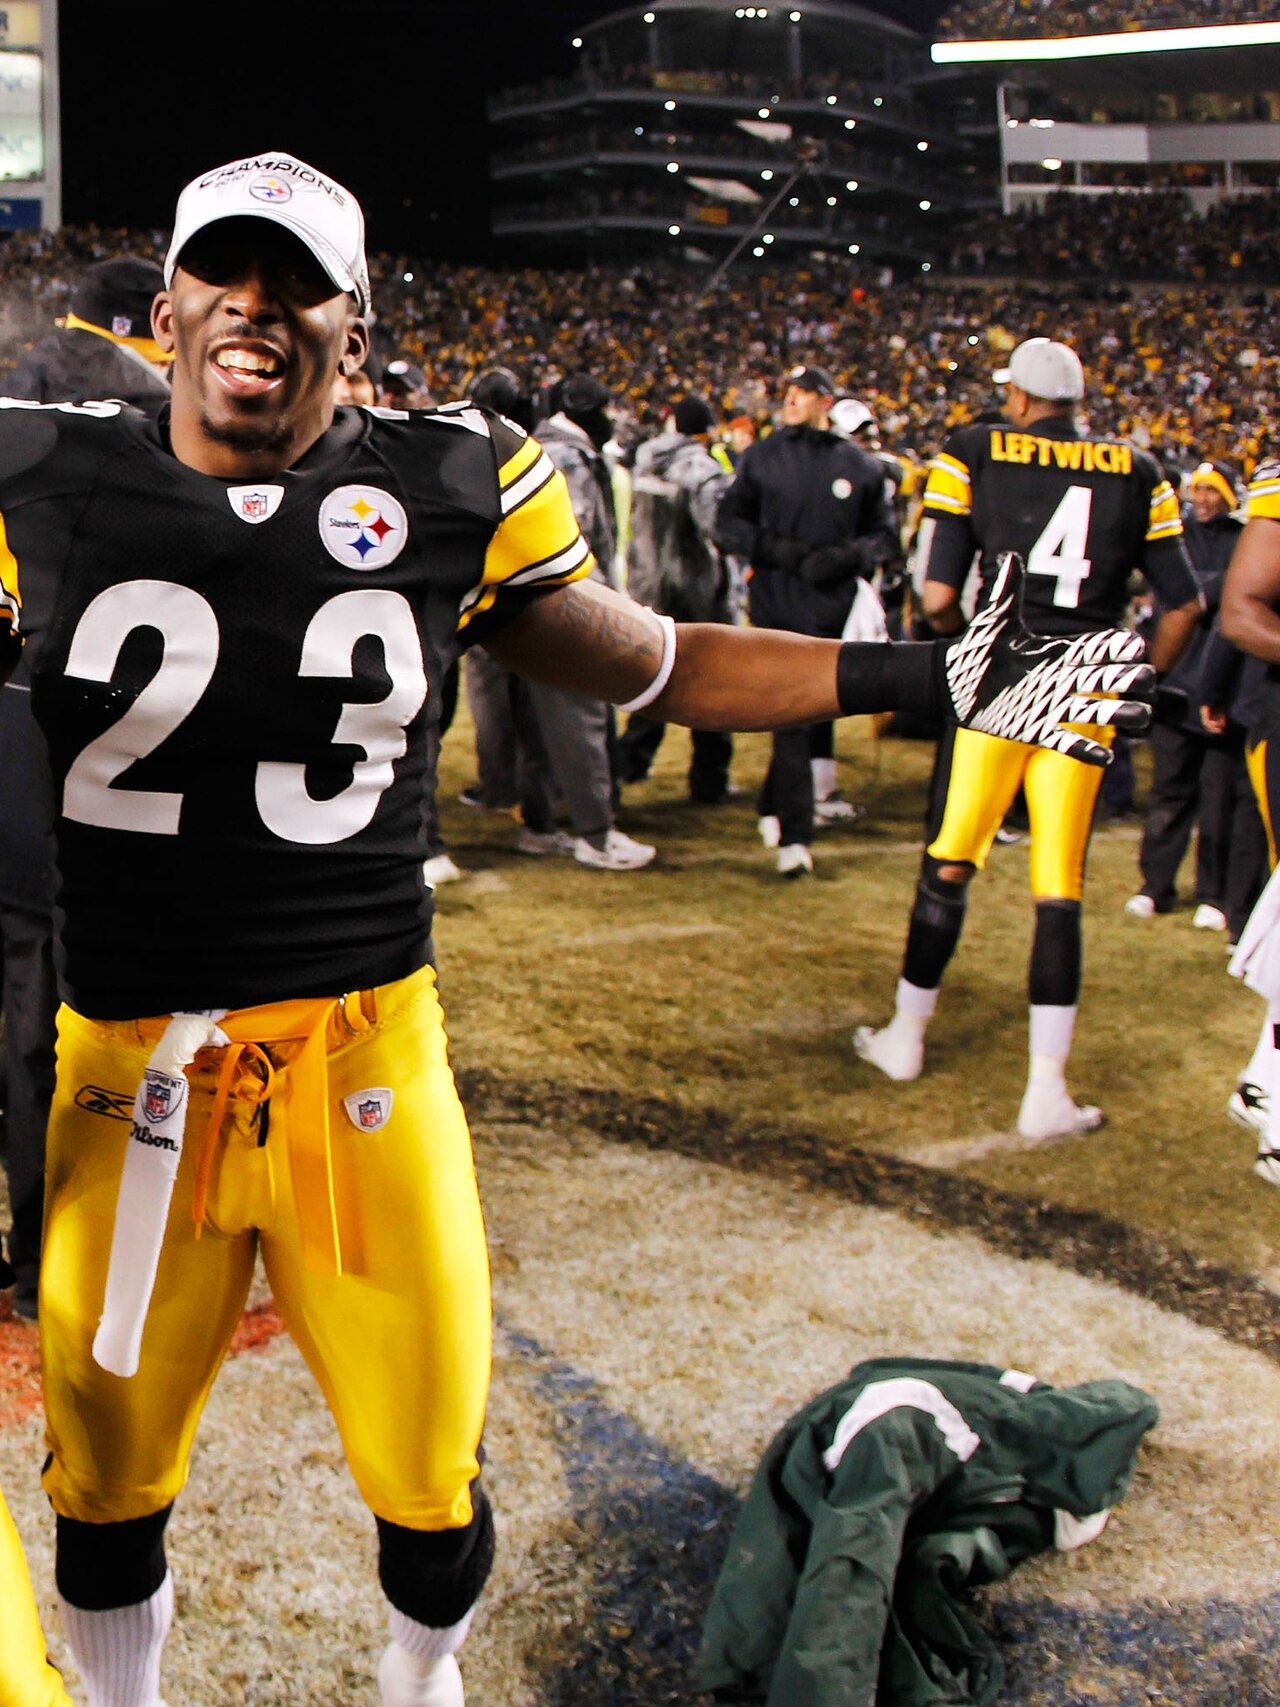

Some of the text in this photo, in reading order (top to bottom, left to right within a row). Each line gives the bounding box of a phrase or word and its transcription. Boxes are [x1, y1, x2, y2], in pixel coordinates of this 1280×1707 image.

[199, 159, 348, 208] CHAMPIONS
[989, 429, 1133, 476] LEFTWICH
[328, 517, 361, 530] Steelers
[1027, 485, 1094, 610] 4
[62, 578, 429, 846] 23
